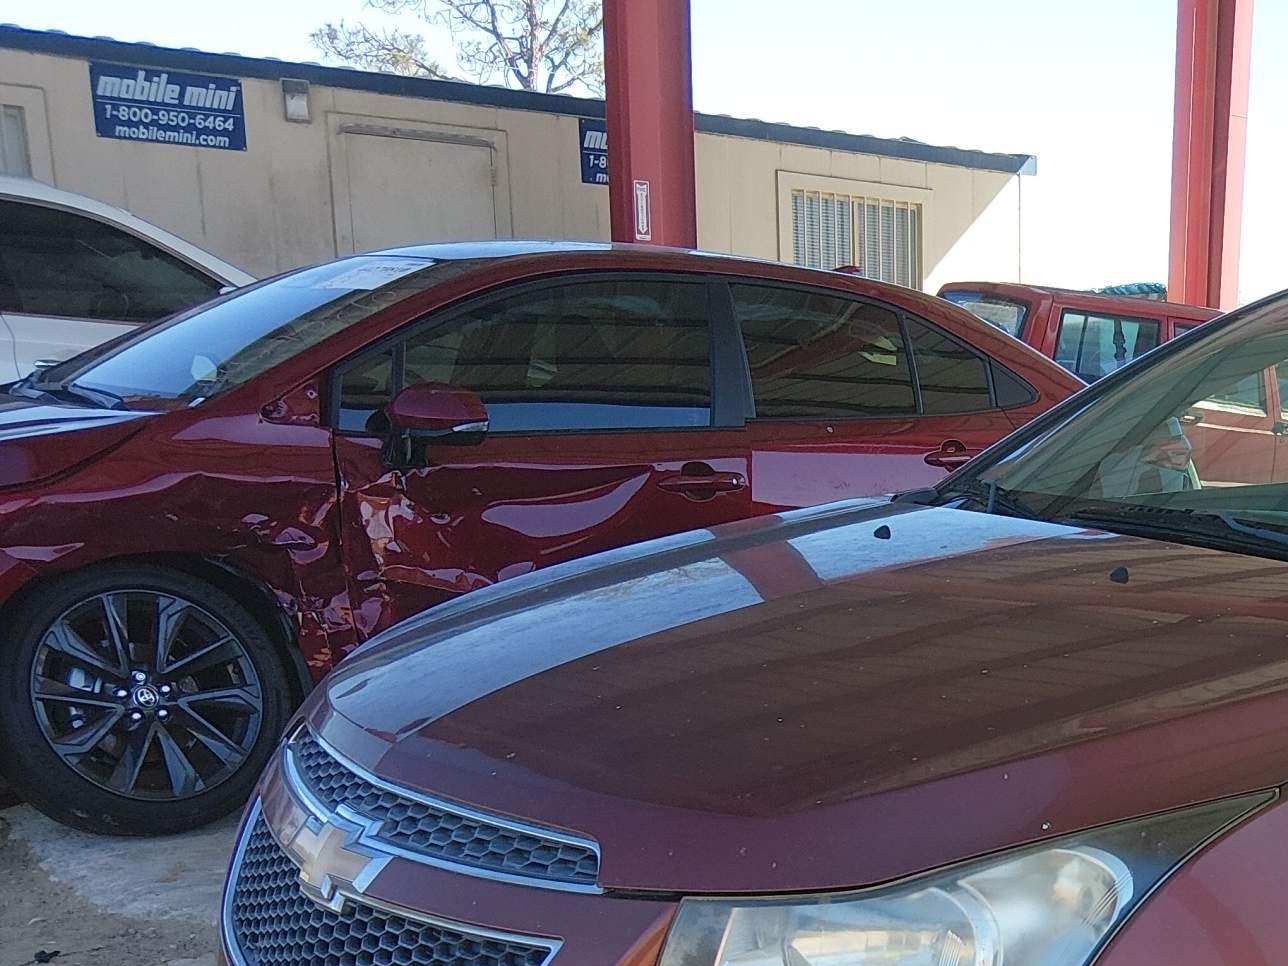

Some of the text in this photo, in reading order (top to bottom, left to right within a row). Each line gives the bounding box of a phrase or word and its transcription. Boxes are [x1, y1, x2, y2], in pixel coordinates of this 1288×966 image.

[97, 70, 238, 111] mobile mini
[104, 104, 234, 131] 1-800-950-6464
[115, 125, 230, 147] mobilemini.com
